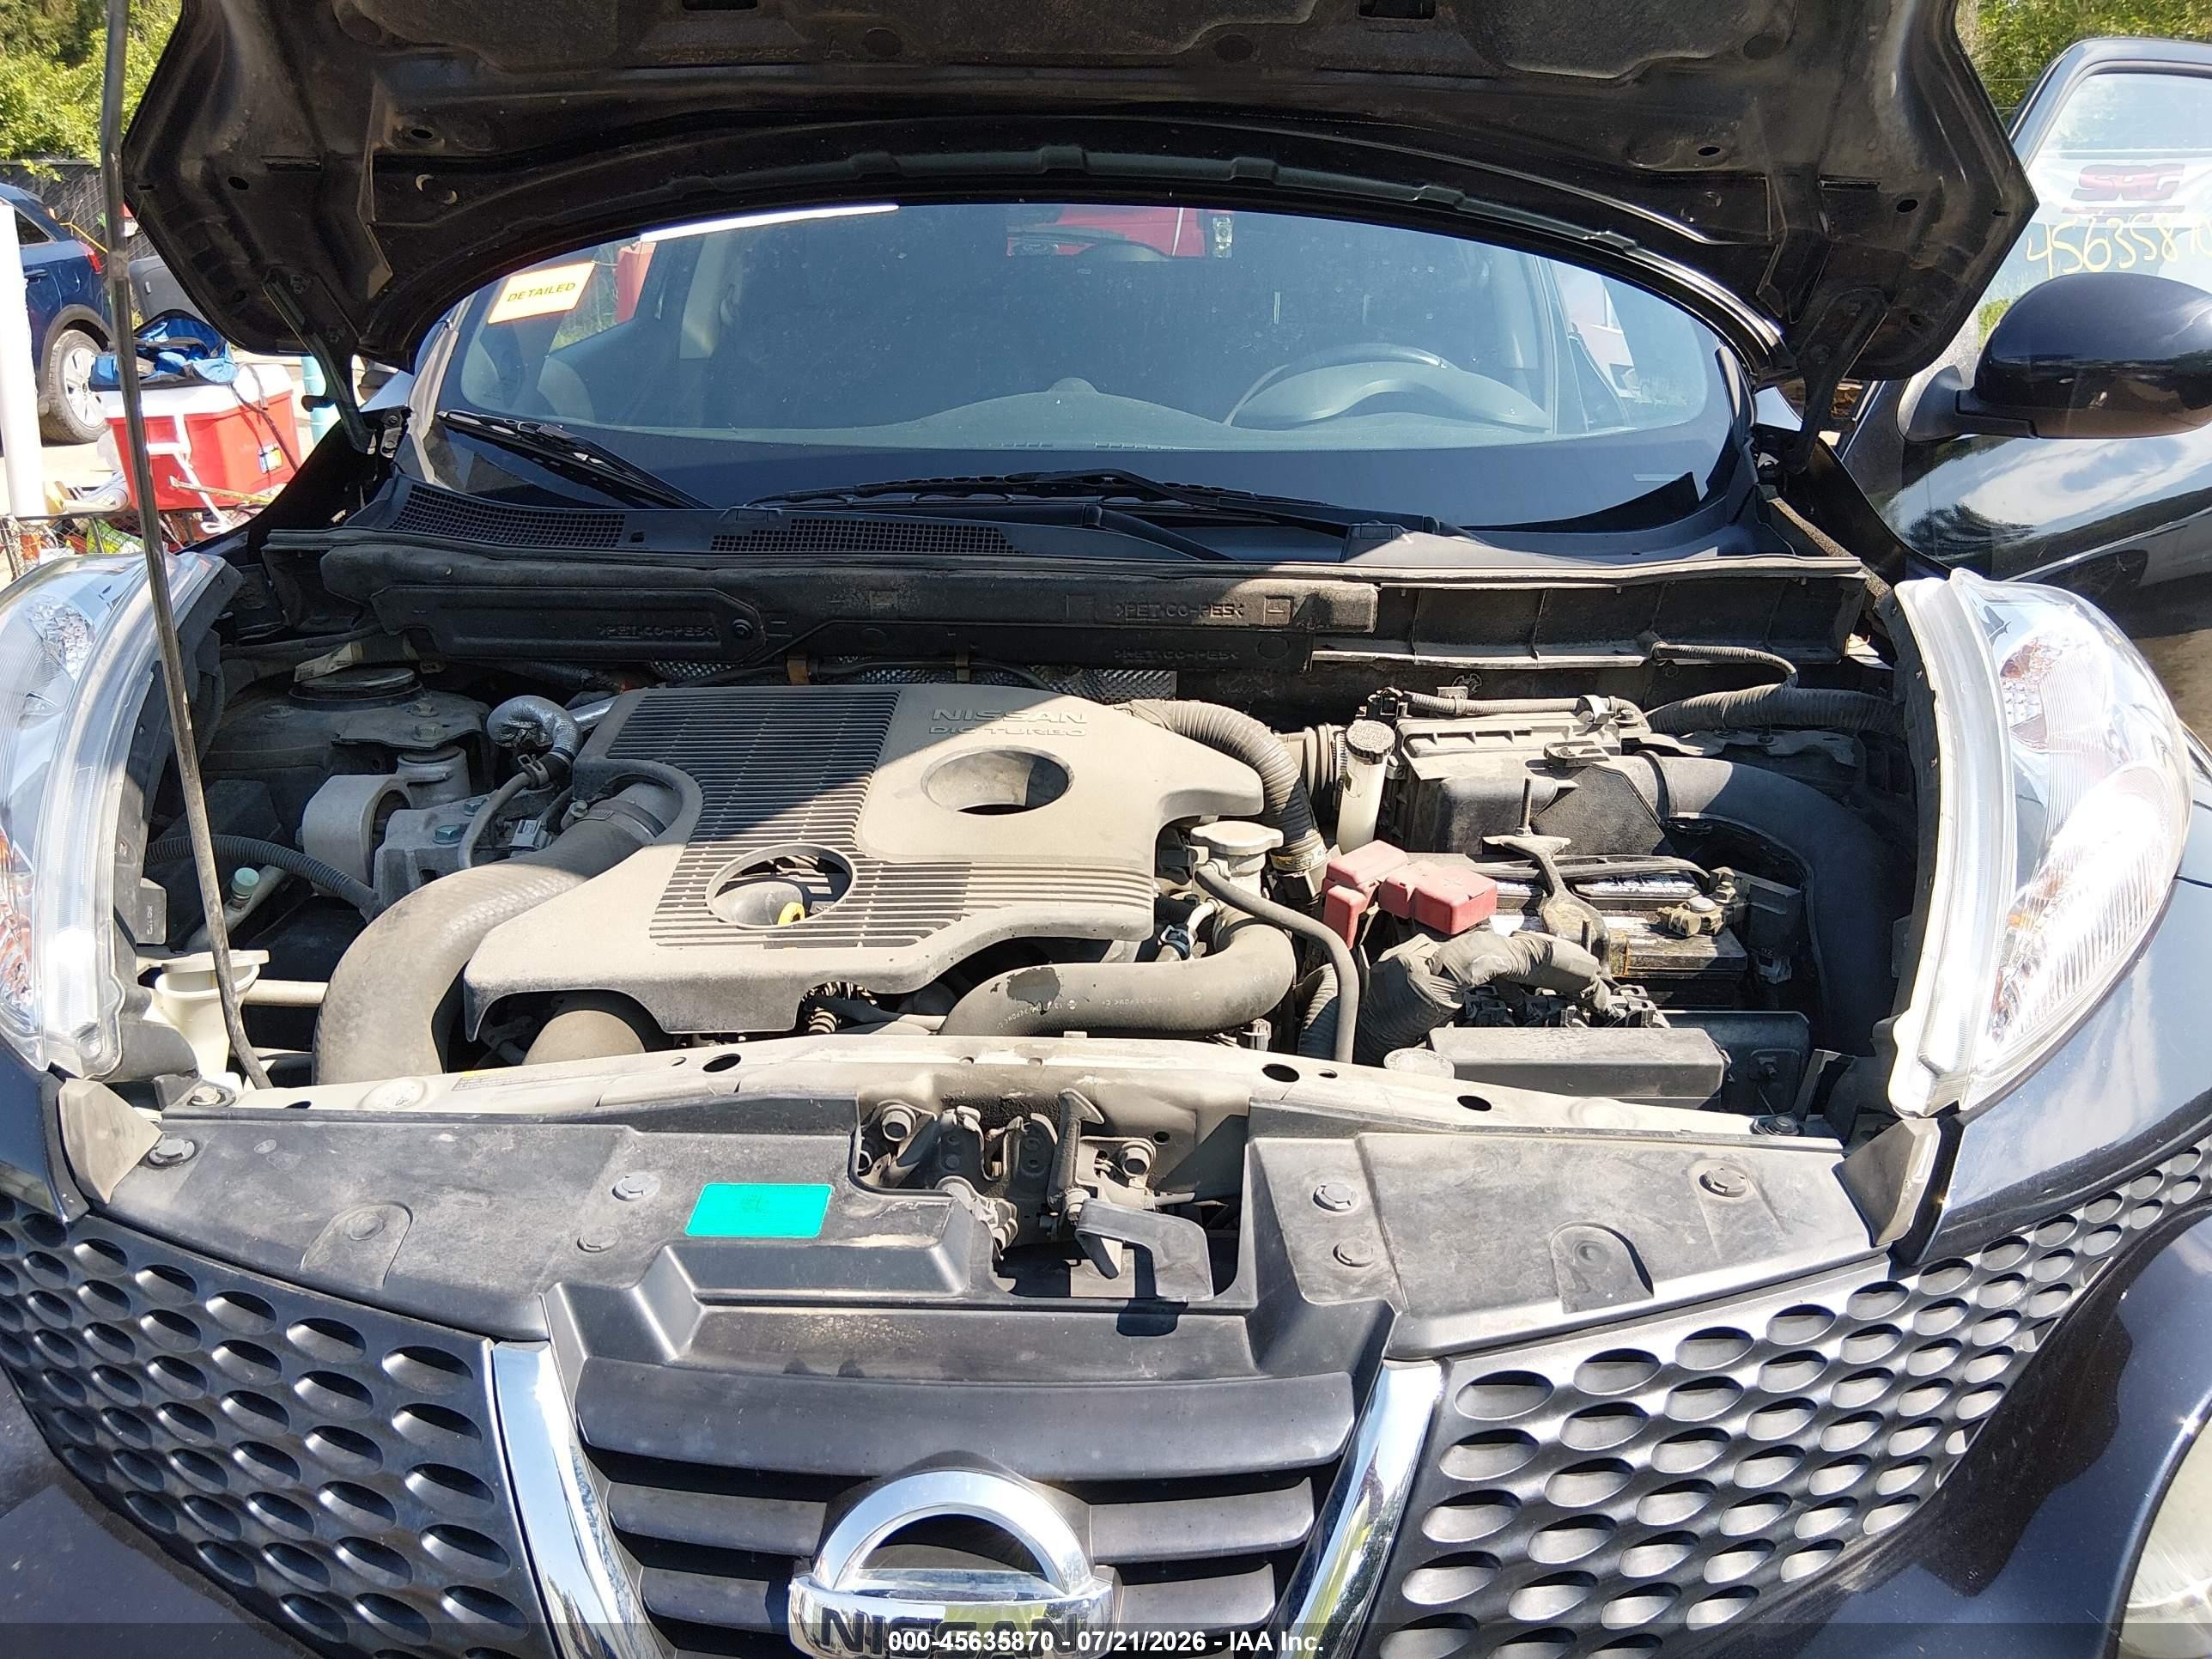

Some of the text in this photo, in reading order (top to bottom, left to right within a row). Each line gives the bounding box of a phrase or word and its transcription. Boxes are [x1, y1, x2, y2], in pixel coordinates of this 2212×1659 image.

[507, 283, 576, 302] DETAILED
[933, 708, 1088, 725] NISSAN
[820, 1606, 1079, 1659] NISSAN
